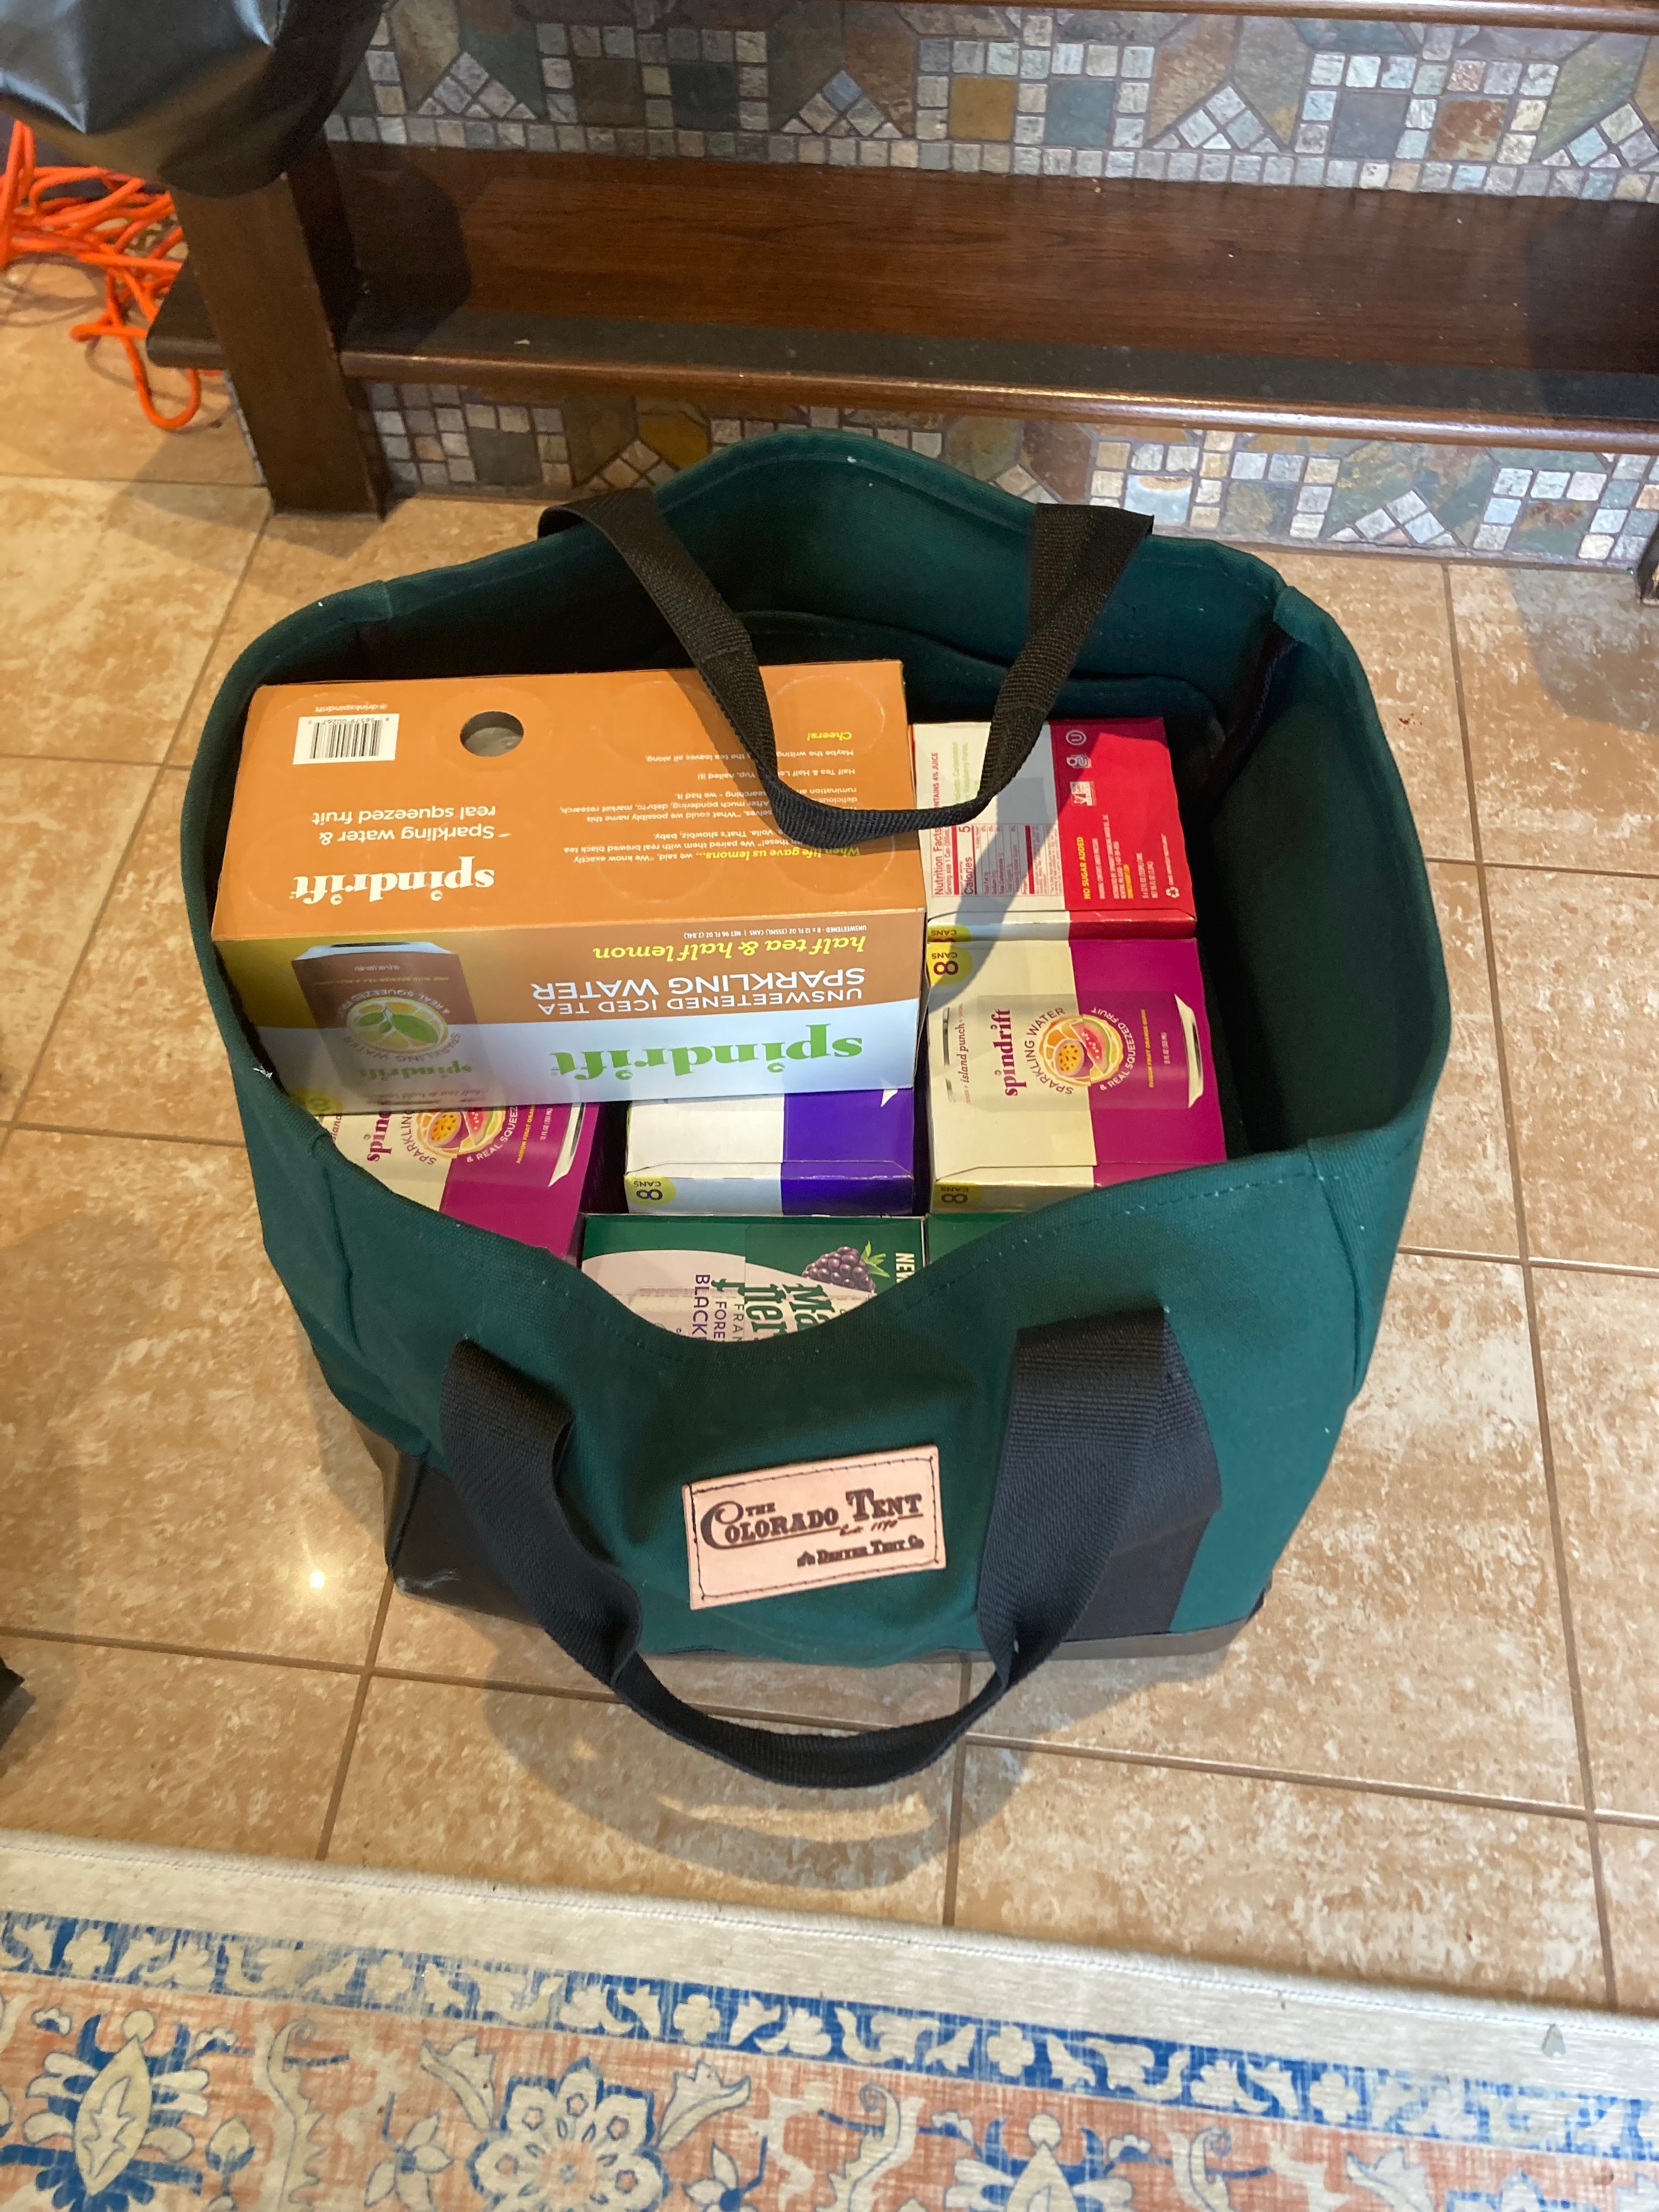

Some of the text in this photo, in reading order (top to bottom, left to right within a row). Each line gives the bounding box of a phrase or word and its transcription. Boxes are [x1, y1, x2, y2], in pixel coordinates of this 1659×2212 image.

[807, 732, 852, 741] Cheers!
[777, 750, 806, 758] writing
[933, 771, 939, 781] 4%
[311, 805, 496, 825] real squeezed fruit
[632, 812, 668, 821] possibly
[671, 802, 718, 810] pondering,
[319, 823, 495, 845] Sparkling water &
[709, 839, 737, 848] paired
[696, 851, 750, 861] lemons...
[770, 847, 799, 858] gave
[802, 848, 822, 859] life
[933, 827, 944, 895] Nutrition Facts
[290, 856, 495, 905] spindrift
[963, 857, 973, 894] Calories
[1076, 837, 1091, 900] NO SUGAR ADDED
[593, 935, 866, 962] half tea & half lemon
[933, 961, 958, 975] 8
[531, 968, 865, 1000] SPARKLING WATER
[418, 993, 443, 1009] REAL
[538, 988, 862, 1015] UNSWEETENED ICED TEA
[1091, 1006, 1119, 1023] FRUIT
[955, 1023, 969, 1052] punch
[1025, 1007, 1073, 1094] SPARKLING WATER
[1118, 1022, 1136, 1069] SQUEEZED
[549, 1024, 862, 1081] spindrift
[991, 1009, 1027, 1096] spindrift
[957, 1054, 970, 1083] island
[1107, 1071, 1130, 1087] REAL
[476, 1144, 503, 1160] REAL
[500, 1106, 518, 1142] SQUEEZ
[517, 1124, 531, 1164] PASSION FRUIT
[636, 1189, 663, 1201] 8
[941, 1193, 968, 1204] 8
[692, 1274, 710, 1335] BLACK
[714, 1301, 726, 1339] FORE
[732, 1304, 744, 1342] FRAN
[701, 1488, 922, 1549] COLORADO TENT
